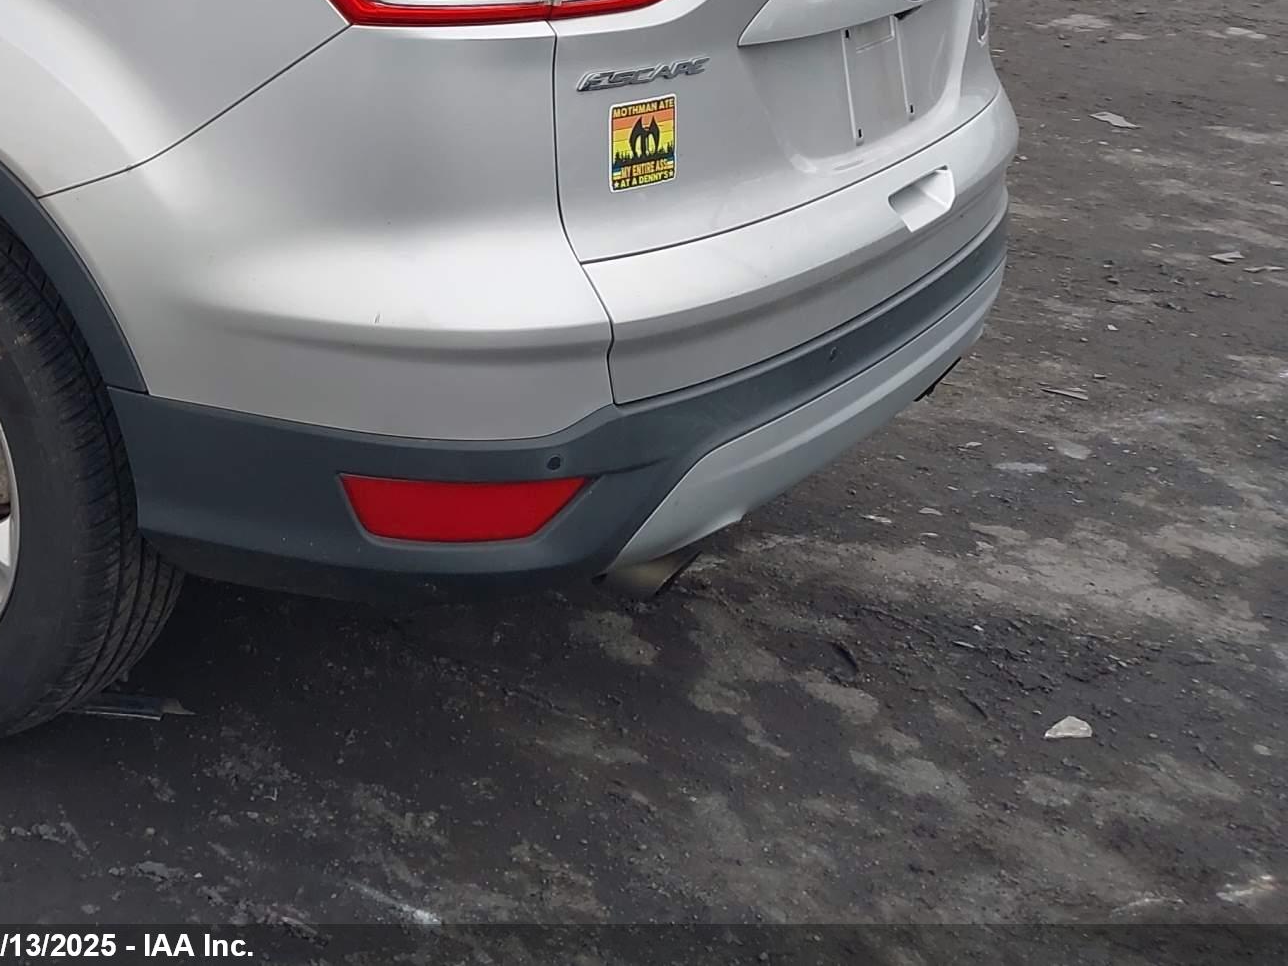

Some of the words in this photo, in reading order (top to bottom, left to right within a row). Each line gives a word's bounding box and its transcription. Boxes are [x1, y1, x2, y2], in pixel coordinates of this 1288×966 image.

[576, 56, 710, 92] ESCAPE
[613, 102, 658, 117] MOTHMAN
[658, 97, 675, 109] ATE
[620, 165, 632, 178] MY
[632, 160, 655, 176] ENTIRE
[655, 158, 668, 172] ASS
[620, 178, 630, 188] AT
[631, 176, 638, 186] A
[638, 170, 669, 184] DENNY'S
